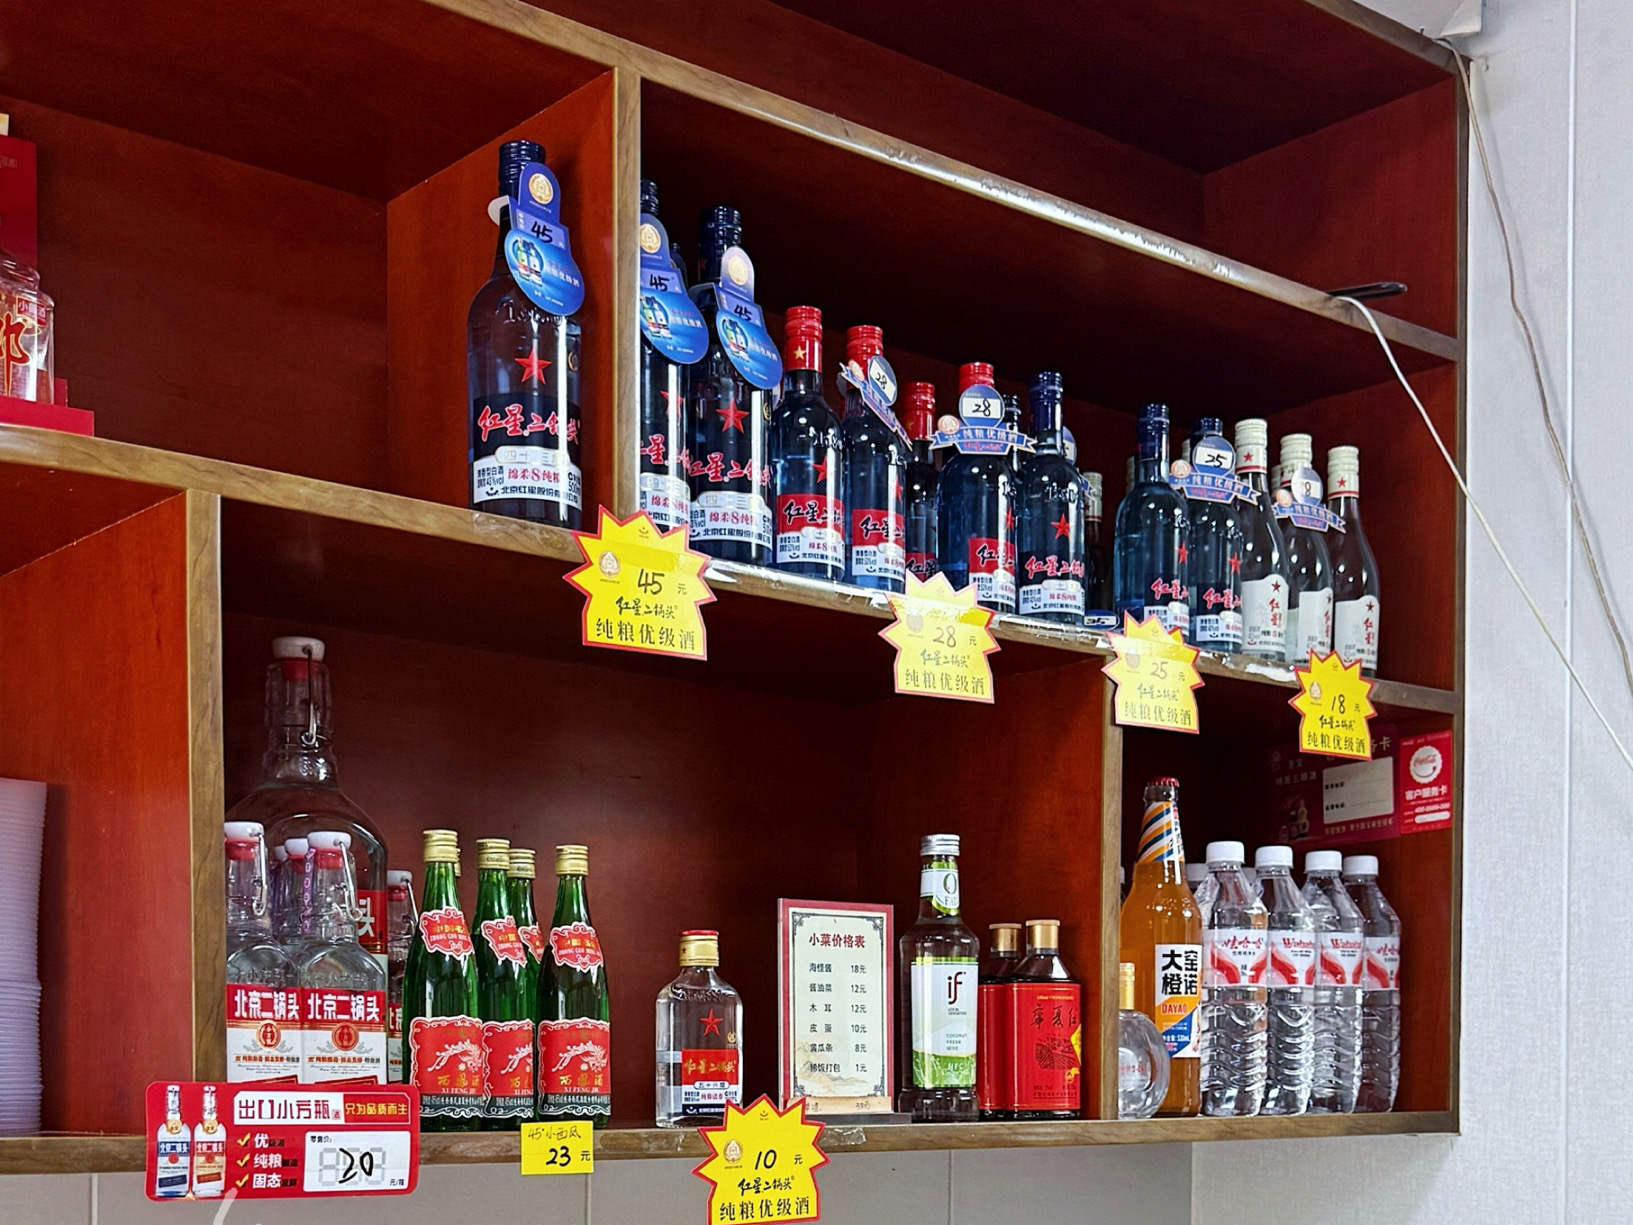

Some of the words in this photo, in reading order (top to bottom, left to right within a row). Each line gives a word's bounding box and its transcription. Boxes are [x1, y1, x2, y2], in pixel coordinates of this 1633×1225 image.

[531, 221, 554, 243] 45
[649, 273, 670, 292] 45
[734, 304, 753, 322] 45
[972, 399, 991, 417] 28
[1205, 453, 1227, 468] 25
[637, 568, 665, 595] 45
[677, 583, 688, 595] 元
[596, 618, 695, 651] 纯粮优级酒
[932, 625, 957, 648] 28
[969, 635, 977, 646] 元
[1150, 661, 1169, 679] 25
[1331, 694, 1346, 714] 18
[809, 933, 865, 948] 小菜价格表
[851, 964, 867, 974] 18元
[1162, 950, 1198, 971] 大窑
[851, 984, 867, 994] 12元
[947, 971, 964, 1006] if
[1162, 973, 1198, 995] 橙诺
[234, 989, 300, 1020] 北京二锅头
[307, 993, 380, 1022] 北京二锅头
[851, 1004, 867, 1014] 12元
[851, 1024, 867, 1033] 10元
[855, 1044, 867, 1053] 8元
[855, 1064, 867, 1073] 1元
[239, 1099, 331, 1119] 出口小方瓶
[345, 1103, 408, 1115] 只为品质而生
[546, 1146, 571, 1167] 23
[581, 1150, 591, 1162] 元
[755, 1149, 777, 1170] 10
[794, 1154, 803, 1165] 元
[738, 1177, 792, 1197] 红星二锅头
[719, 1196, 810, 1221] 纯粮优级酒
